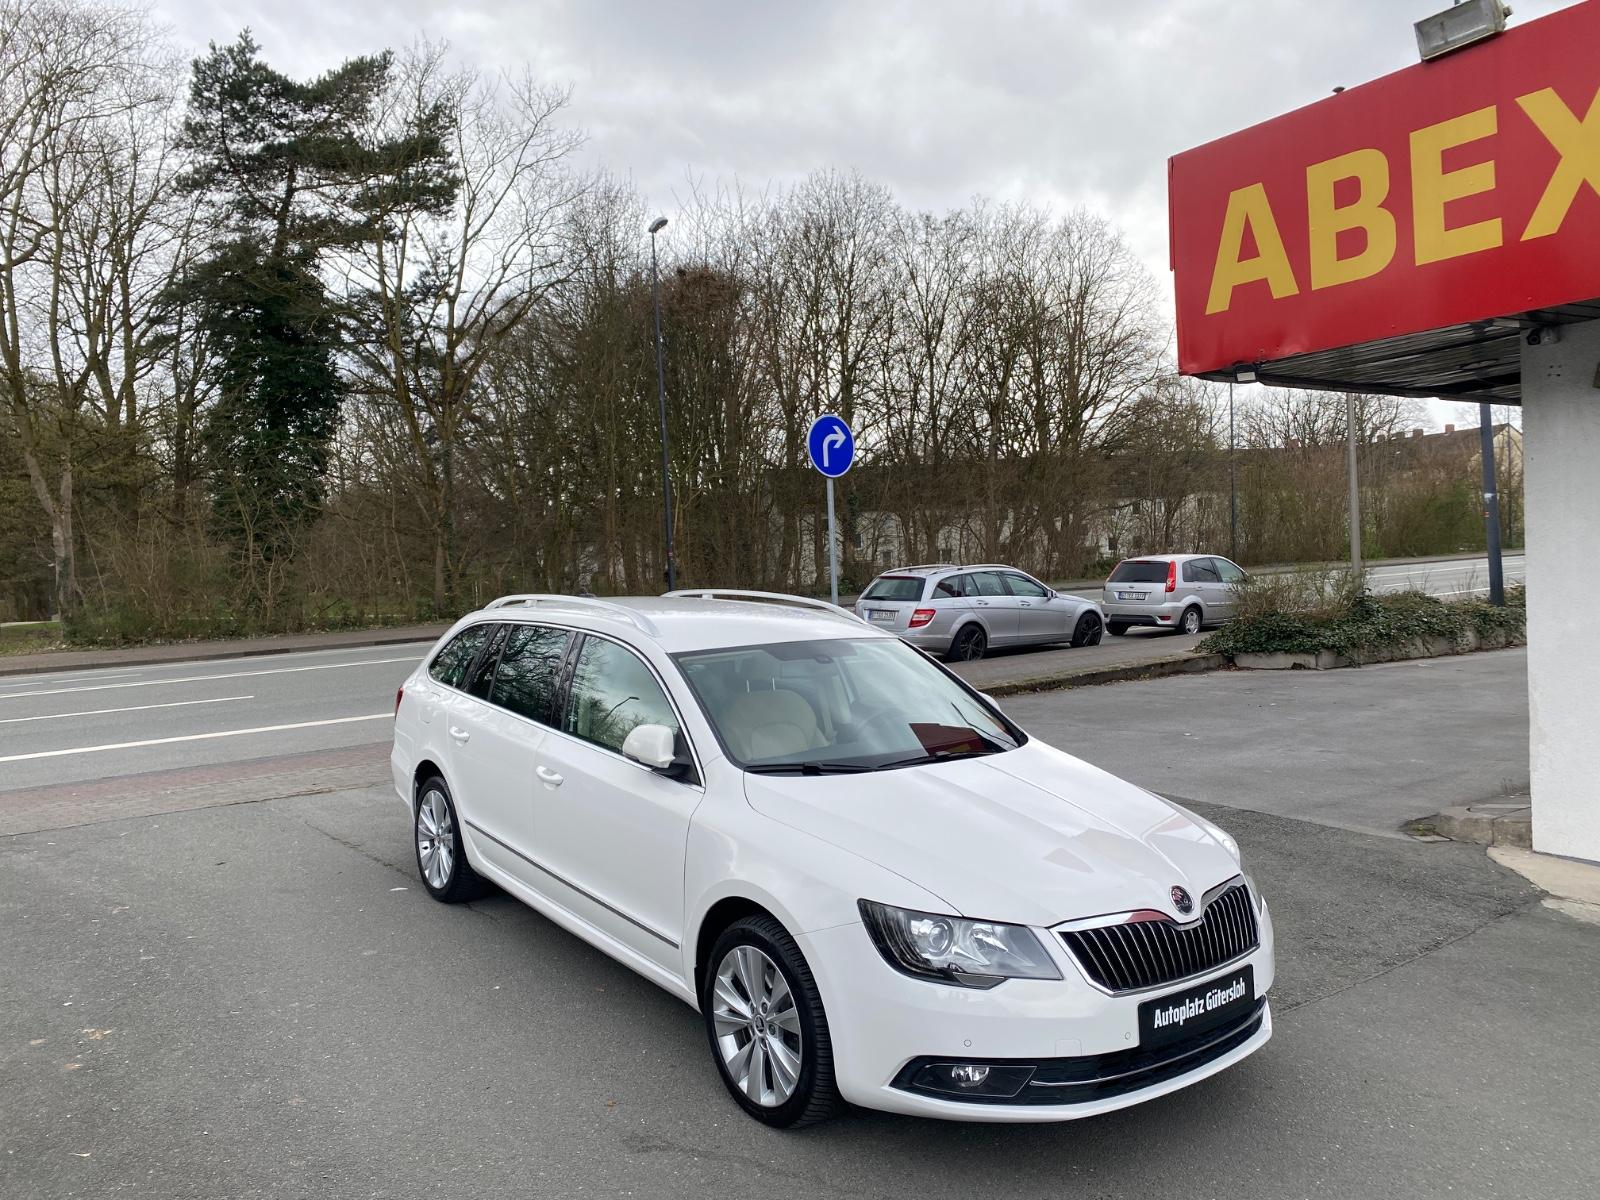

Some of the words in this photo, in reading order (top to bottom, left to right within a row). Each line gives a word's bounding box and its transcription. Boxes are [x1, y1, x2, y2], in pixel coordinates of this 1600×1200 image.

[1205, 85, 1600, 315] ABEX
[1154, 997, 1205, 1028] Autoplatz
[1205, 977, 1245, 1011] Gütersloh
